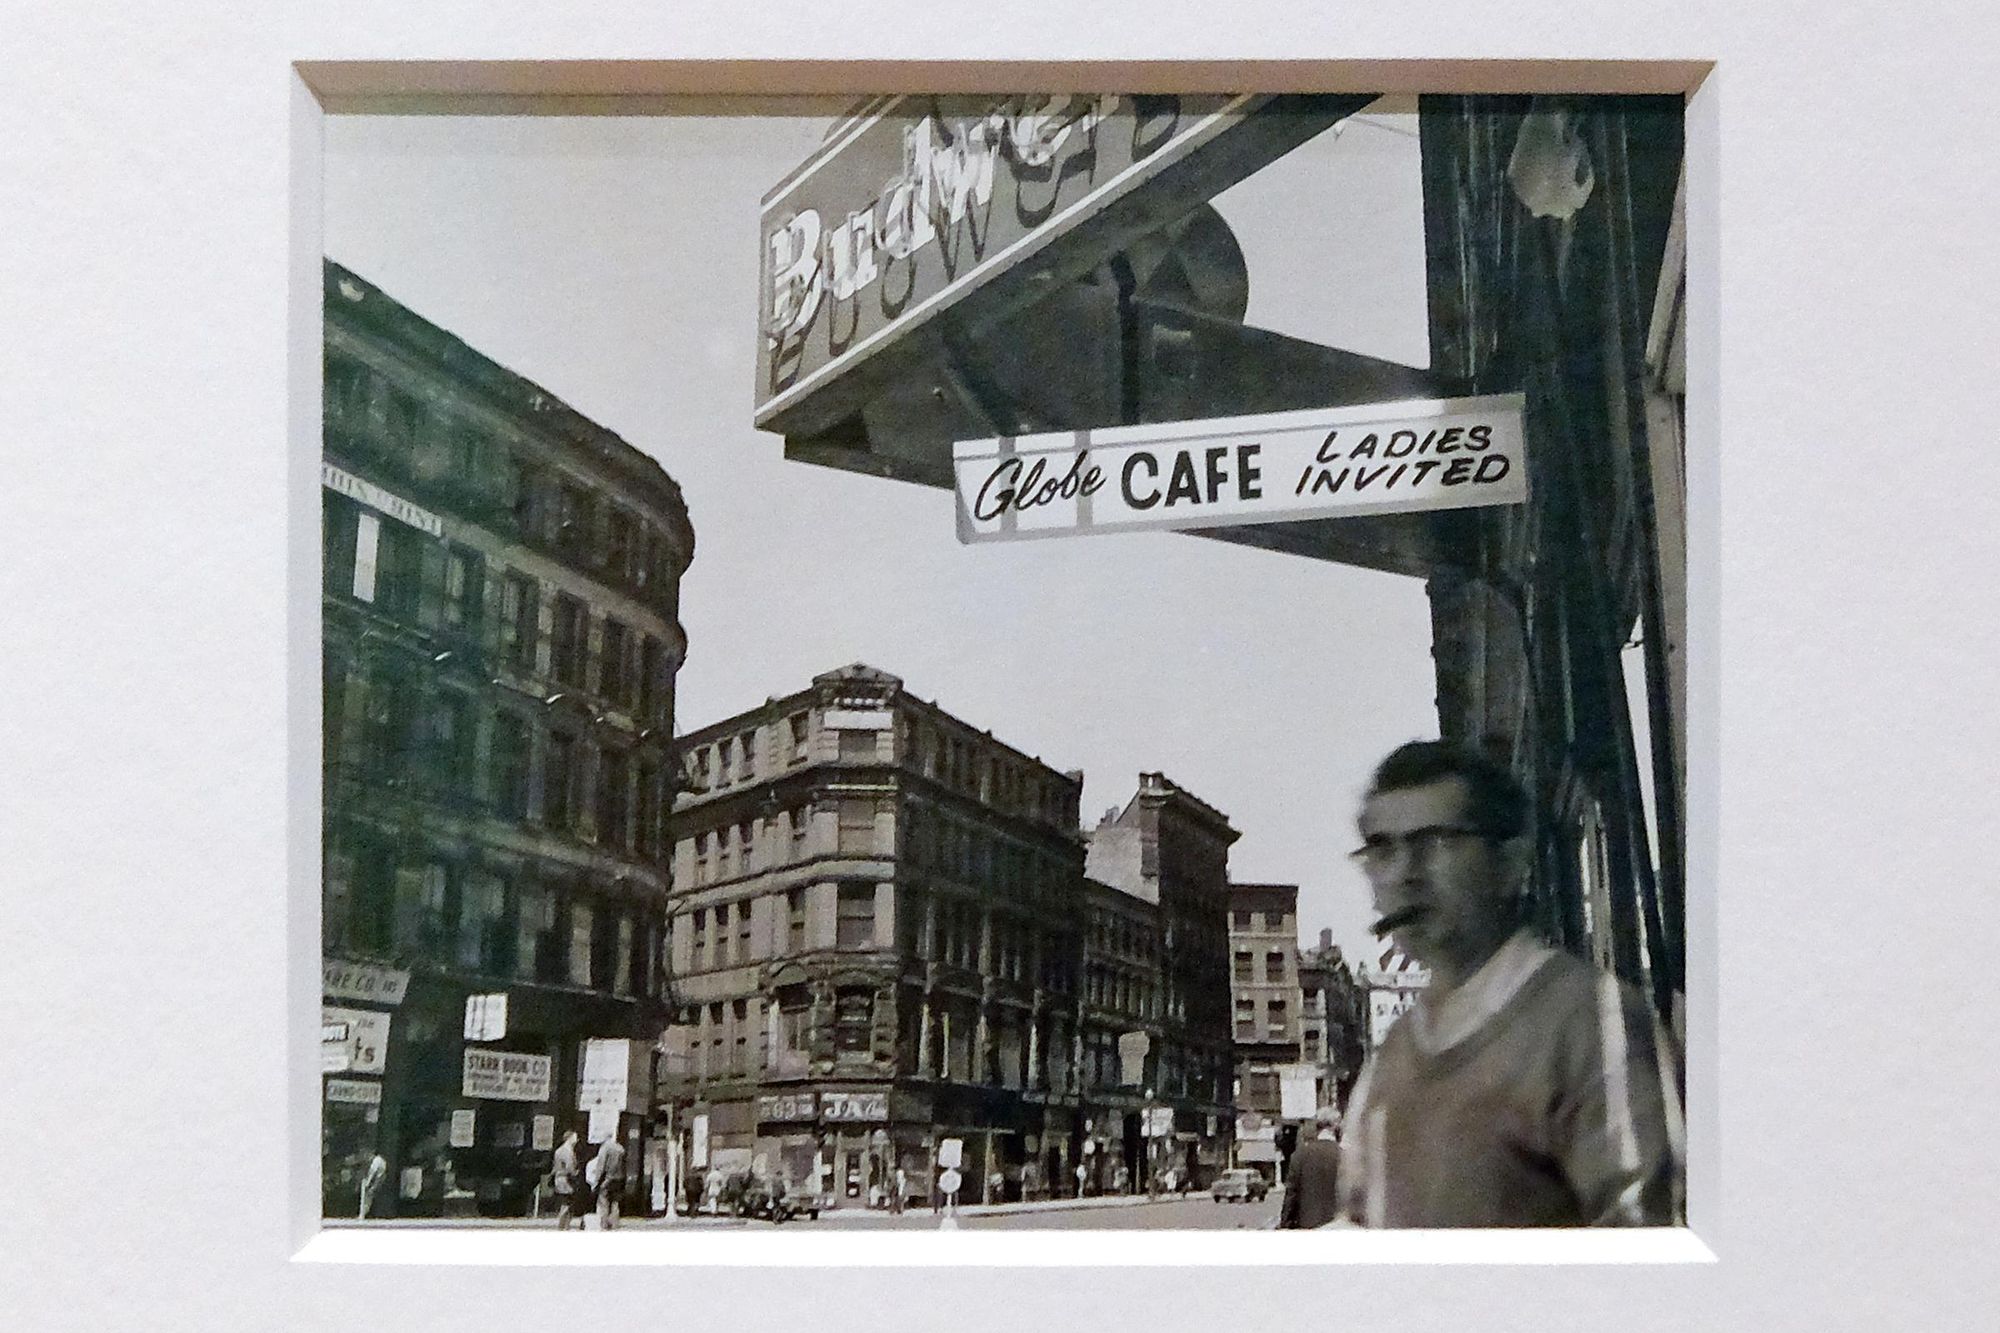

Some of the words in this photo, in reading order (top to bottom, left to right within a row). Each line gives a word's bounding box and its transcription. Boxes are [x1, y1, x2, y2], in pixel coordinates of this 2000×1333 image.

[1316, 425, 1493, 464] LADIES
[974, 449, 1106, 521] Globe
[1121, 444, 1263, 510] CAFE
[1295, 454, 1511, 497] INVITED
